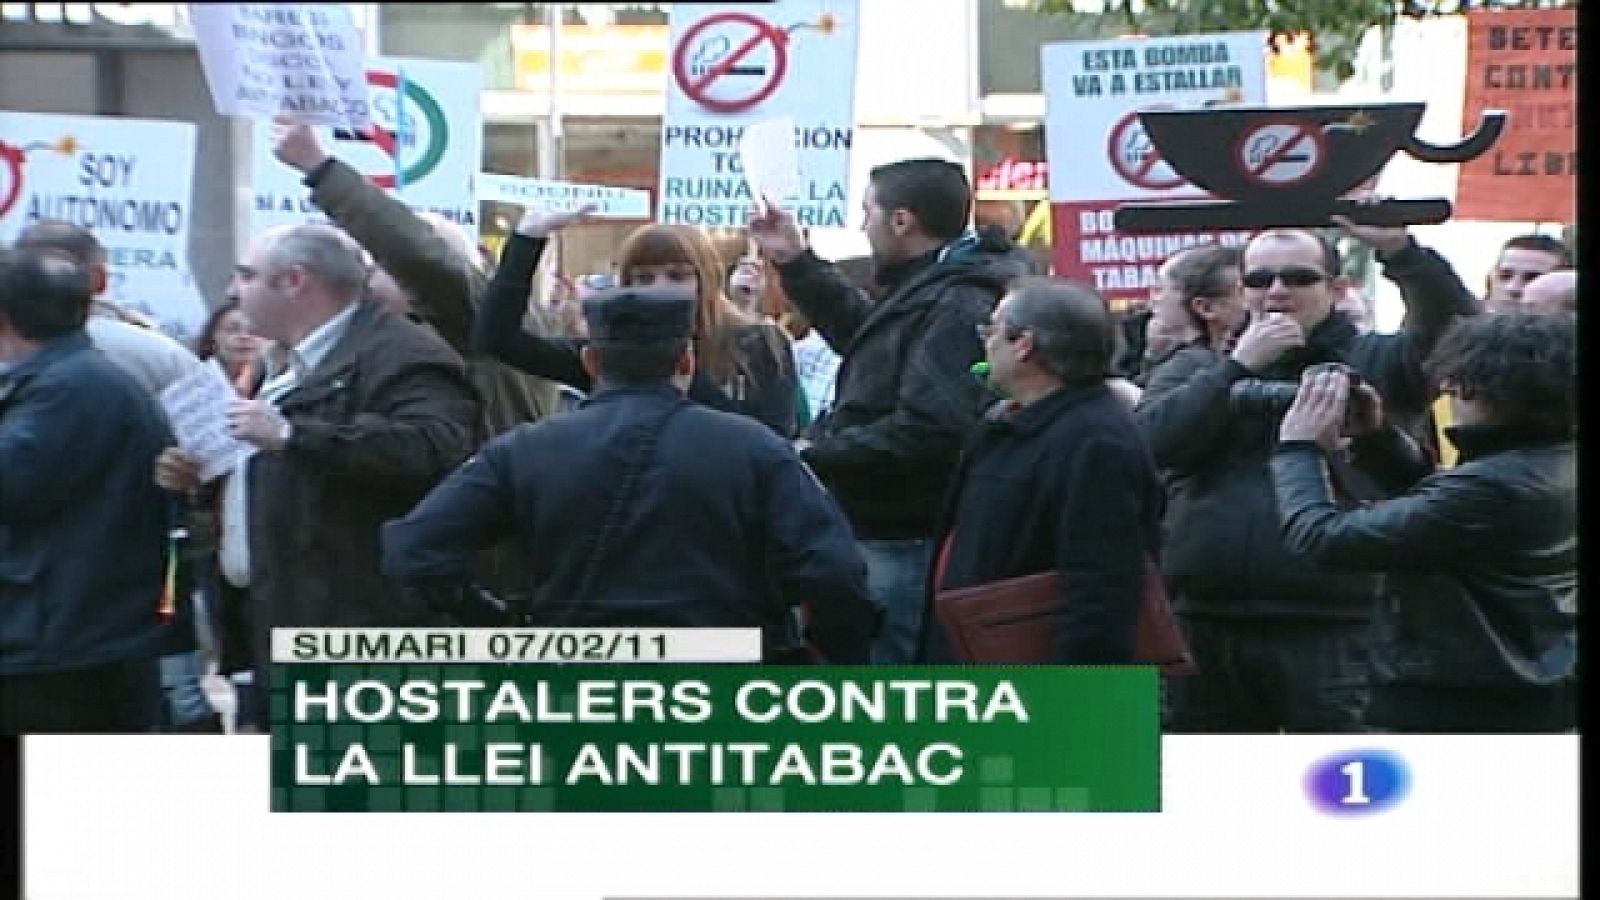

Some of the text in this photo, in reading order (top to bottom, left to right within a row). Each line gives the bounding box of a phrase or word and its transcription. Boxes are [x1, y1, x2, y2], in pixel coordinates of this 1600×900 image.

[1083, 41, 1230, 72] ESTA BOMBA
[1073, 65, 1243, 97] VA A ESTALLAR
[79, 151, 137, 188] SOY
[665, 176, 846, 201] RUINA LA
